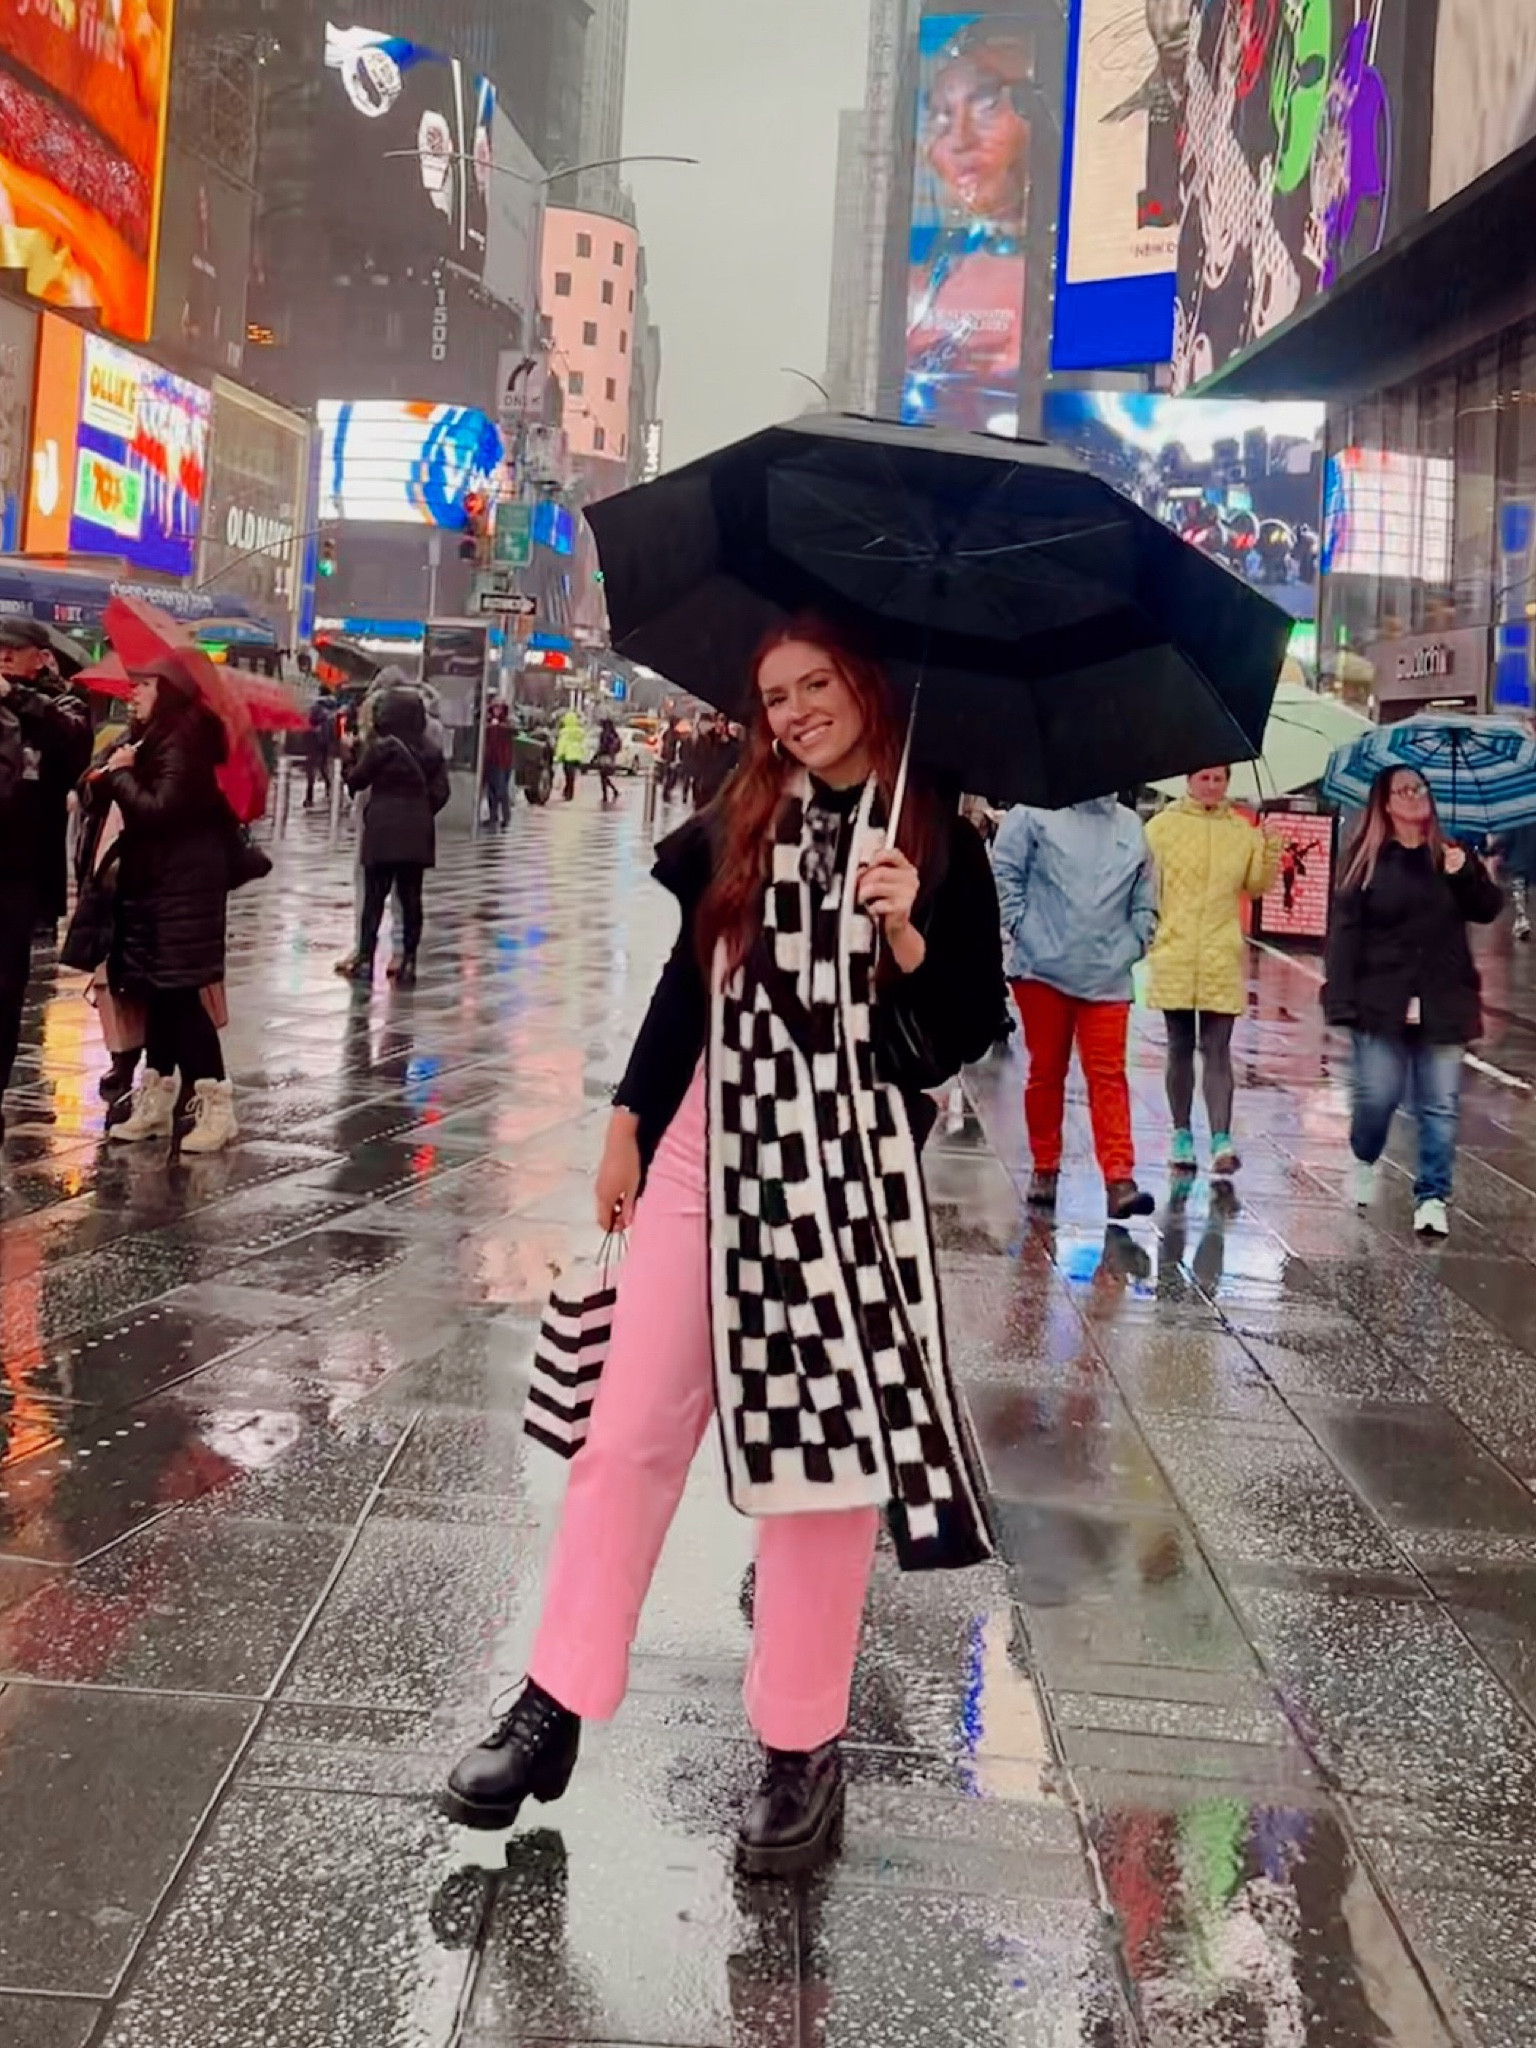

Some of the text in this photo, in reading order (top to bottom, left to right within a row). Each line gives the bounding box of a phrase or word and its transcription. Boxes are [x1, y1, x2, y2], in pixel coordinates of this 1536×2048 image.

[432, 288, 448, 361] 1500
[226, 506, 293, 561] OLD NAVY
